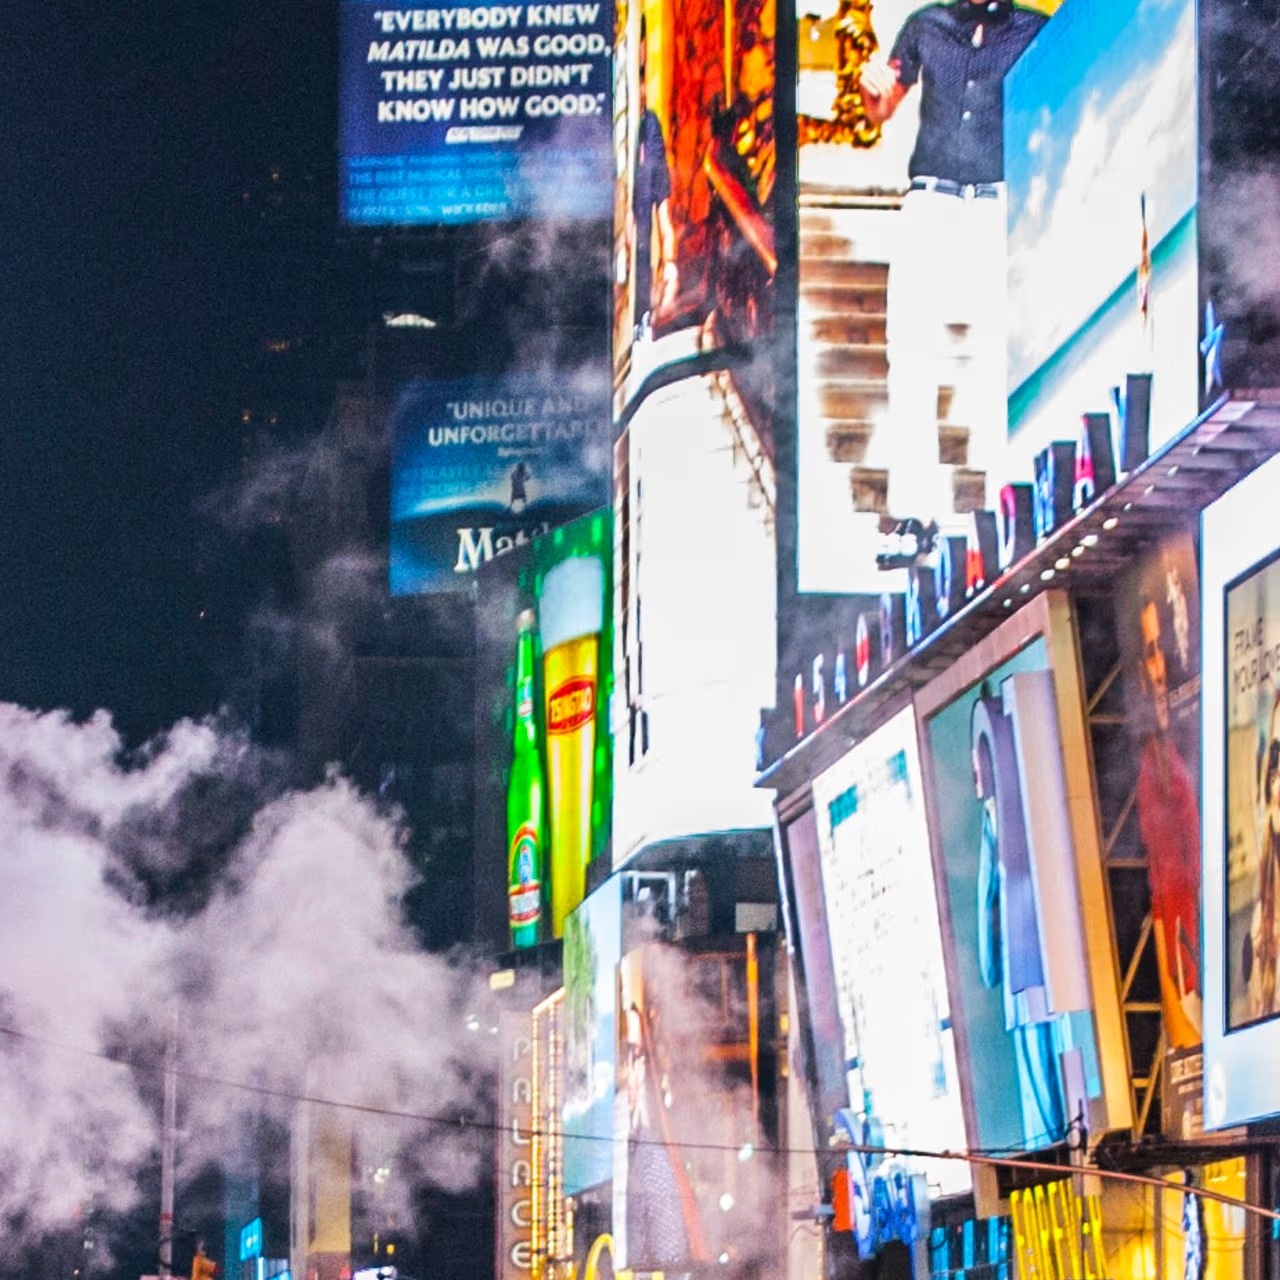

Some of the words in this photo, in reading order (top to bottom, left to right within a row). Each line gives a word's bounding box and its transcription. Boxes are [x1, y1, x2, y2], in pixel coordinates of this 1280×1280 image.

[526, 4, 599, 26] KNEW
[367, 39, 470, 62] MATILDA
[476, 37, 529, 58] WAS
[533, 34, 612, 57] GOOD,
[380, 69, 443, 92] THEY
[448, 67, 505, 90] JUST
[510, 64, 593, 87] DIDN'T
[377, 98, 455, 122] KNOW
[459, 96, 519, 119] HOW
[511, 1037, 532, 1269] PALACE
